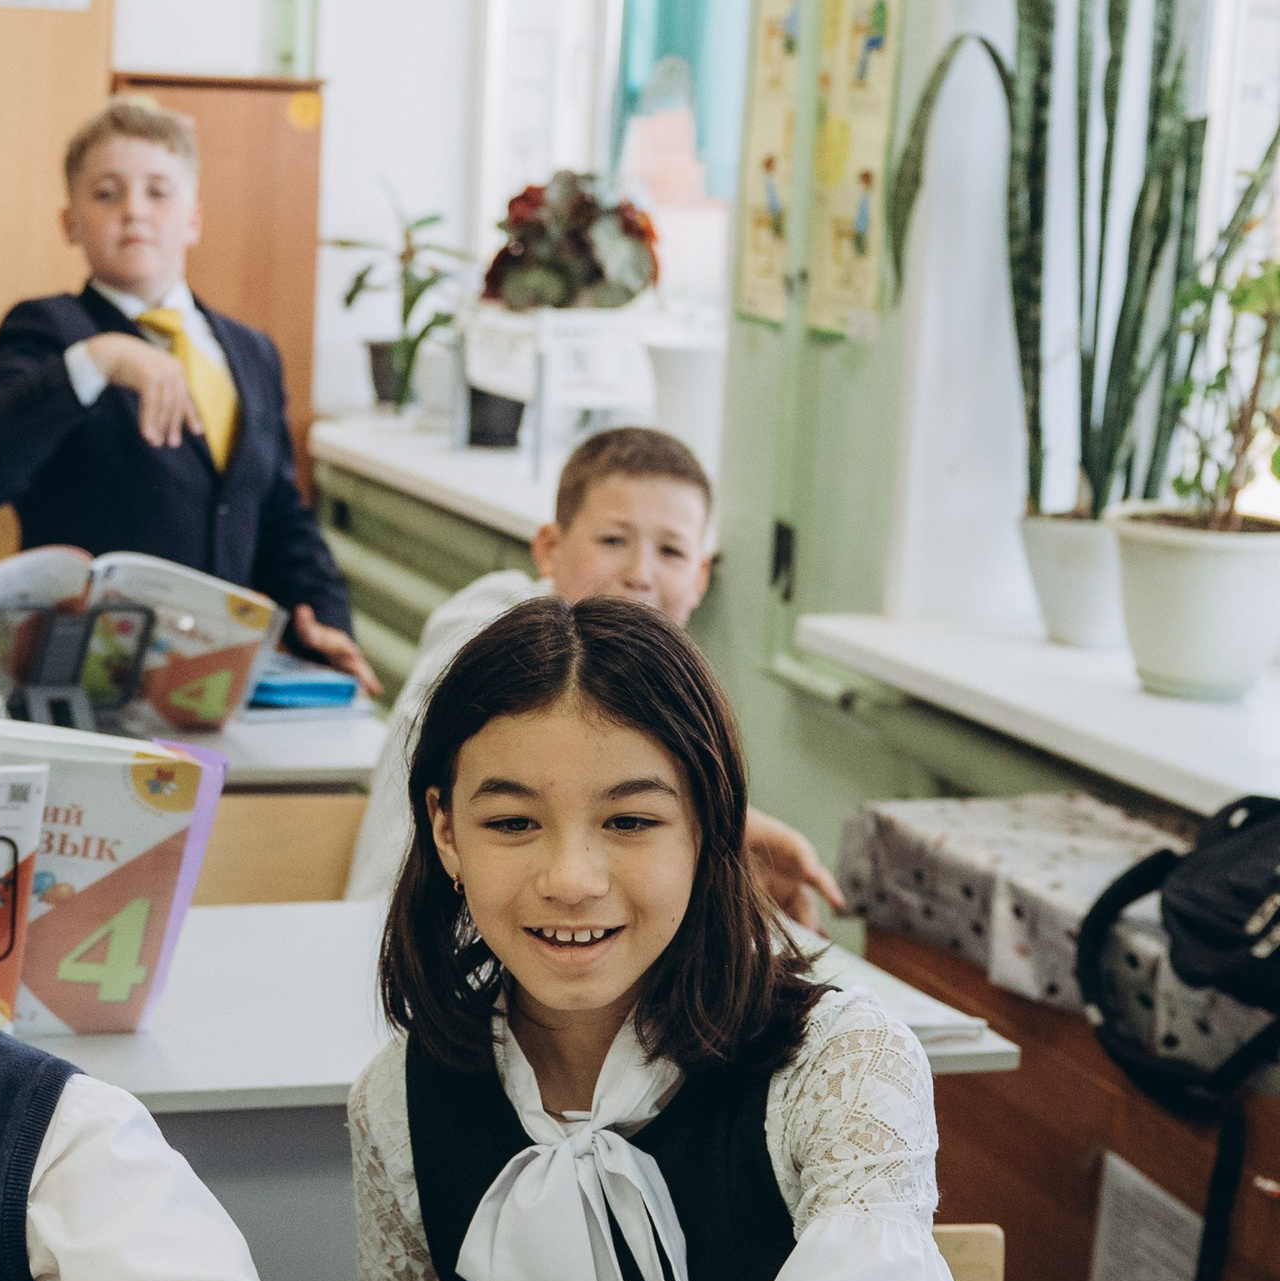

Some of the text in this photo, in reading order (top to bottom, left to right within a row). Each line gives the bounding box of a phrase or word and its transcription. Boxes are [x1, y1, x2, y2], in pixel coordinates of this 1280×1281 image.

[169, 670, 234, 719] 4
[38, 829, 121, 864] ЗЫК
[56, 898, 152, 1002] 4
